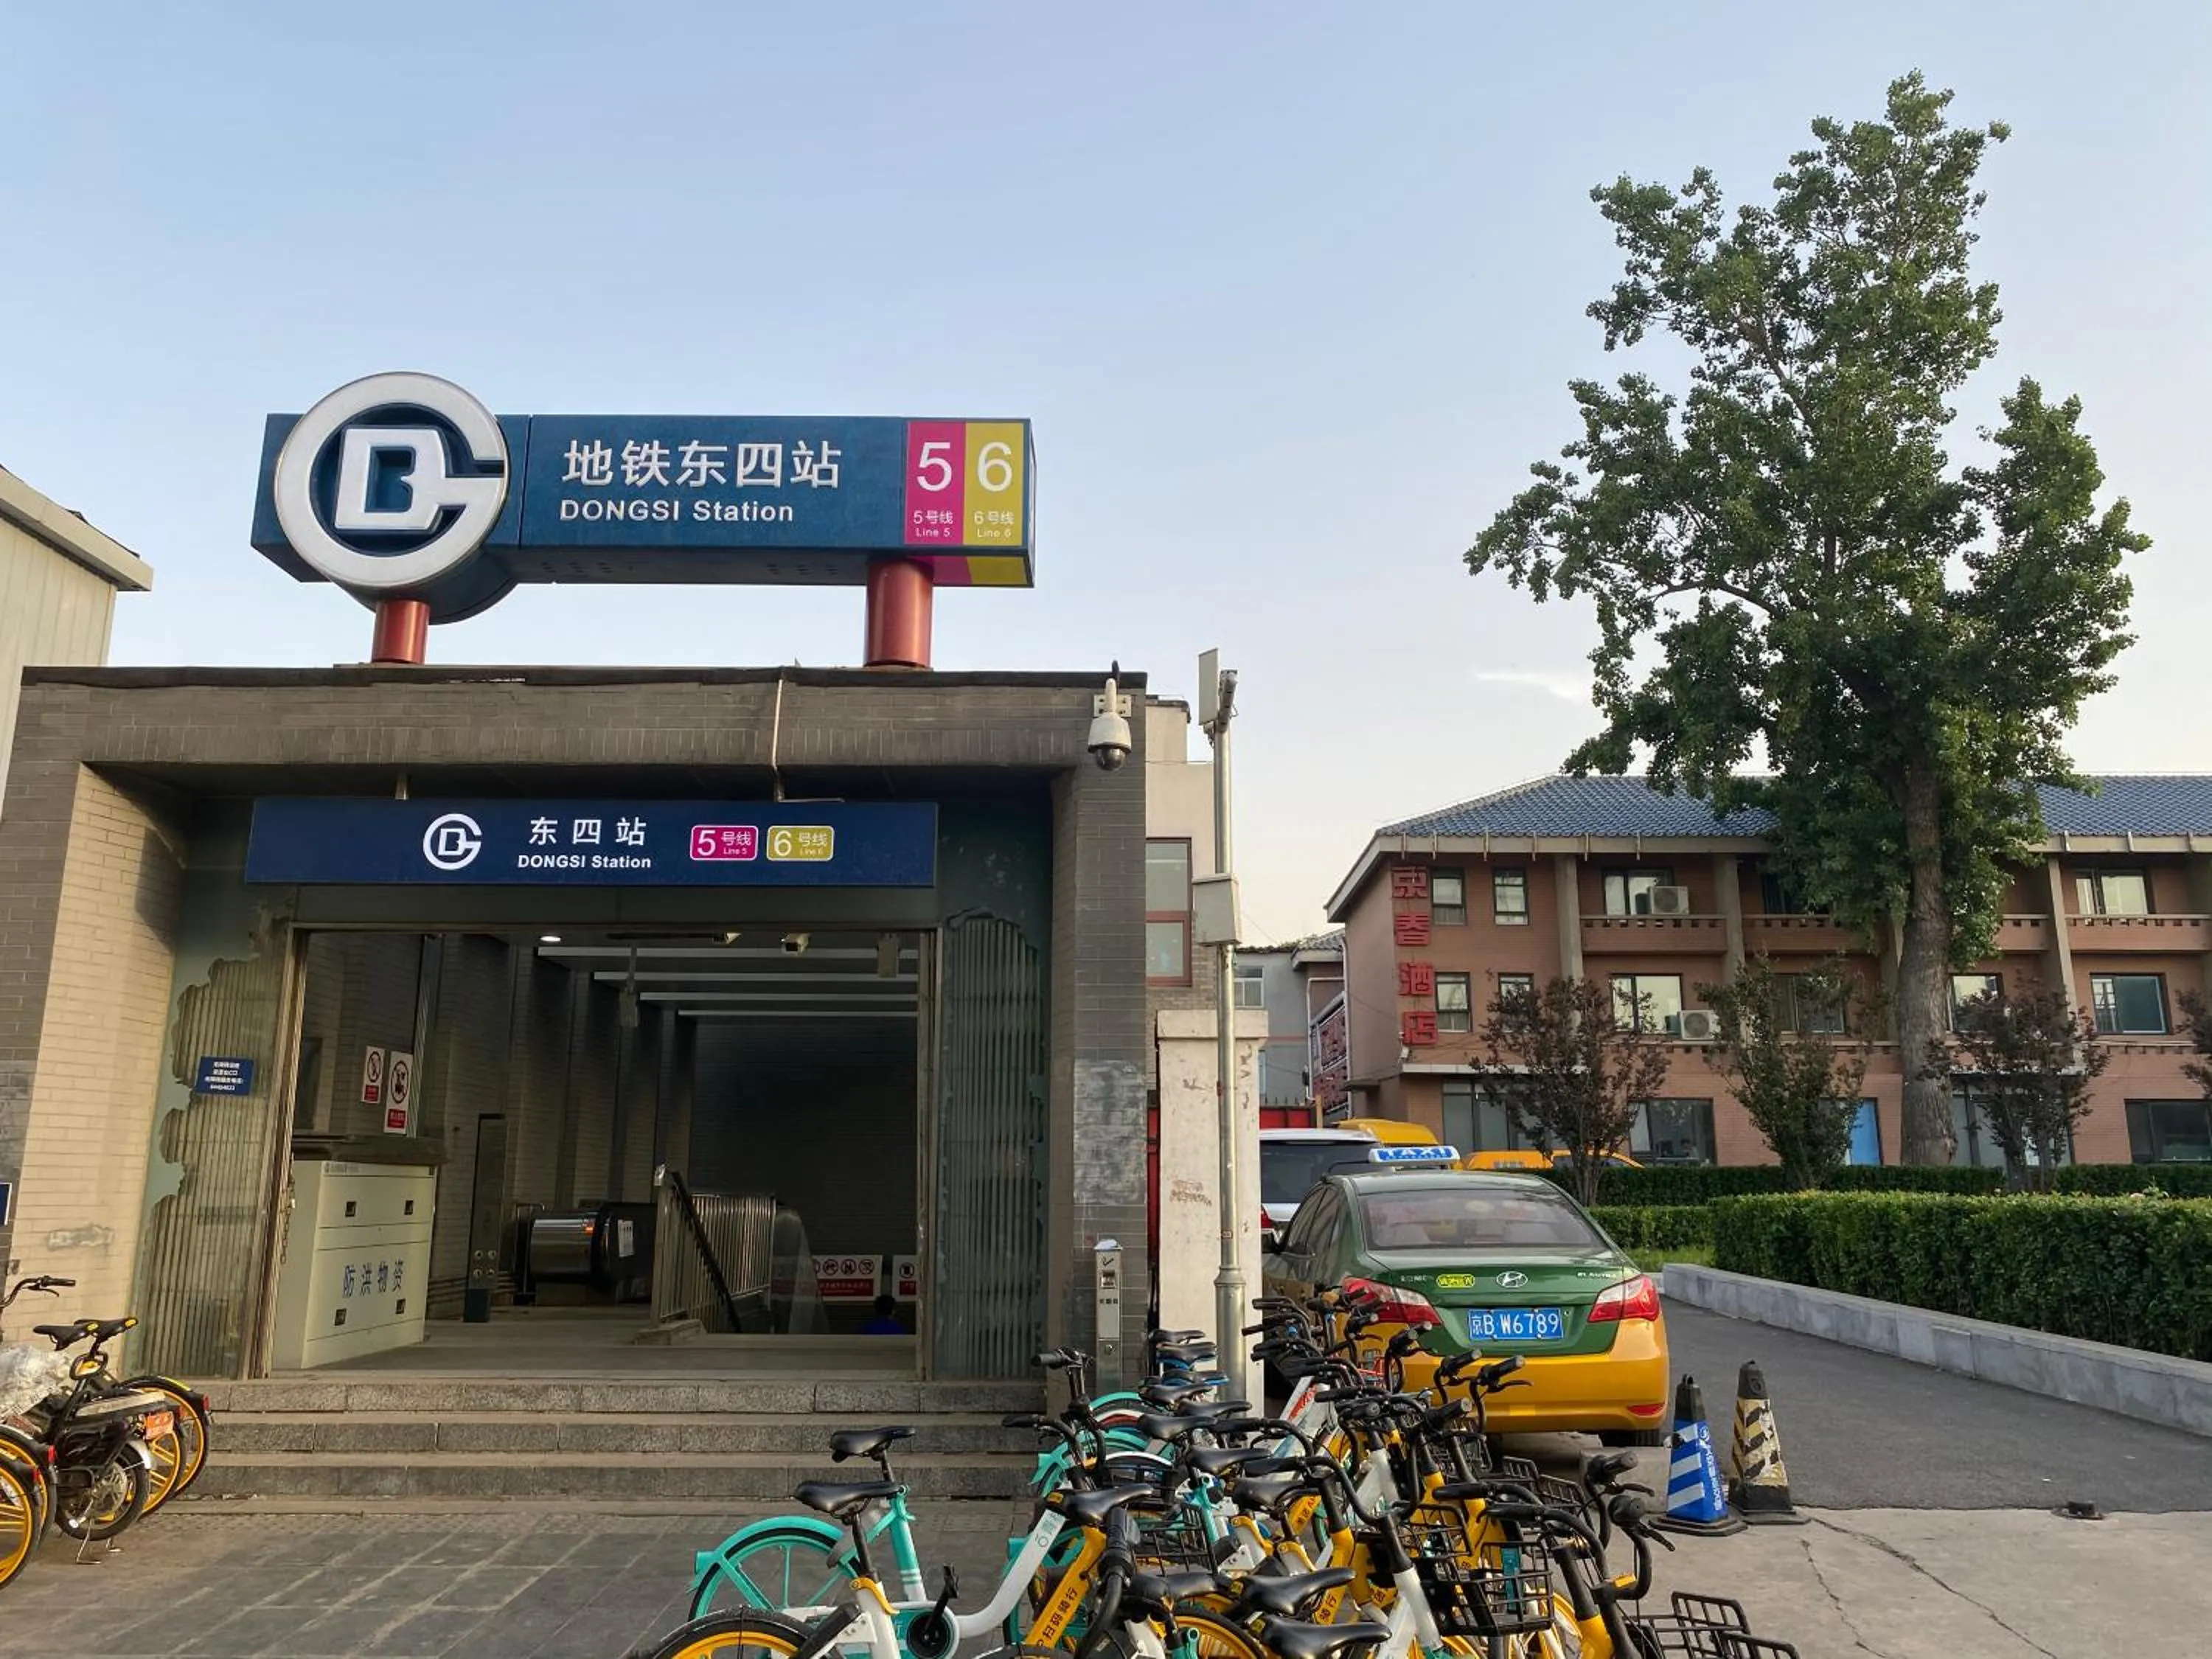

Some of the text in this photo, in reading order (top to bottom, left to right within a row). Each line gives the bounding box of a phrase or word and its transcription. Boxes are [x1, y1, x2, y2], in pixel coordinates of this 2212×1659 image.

[562, 439, 841, 488] 地铁东四站
[917, 442, 952, 492] 5
[977, 442, 1012, 492] 6
[560, 499, 793, 521] DONGSI Station
[914, 509, 953, 524] 5号线
[974, 510, 1015, 525] 6号线
[916, 527, 950, 538] Line 5
[977, 528, 1012, 538] Line 6
[529, 816, 647, 846] 东四站
[518, 854, 651, 869] DONGSI Station
[342, 1259, 405, 1297] 防洪物资
